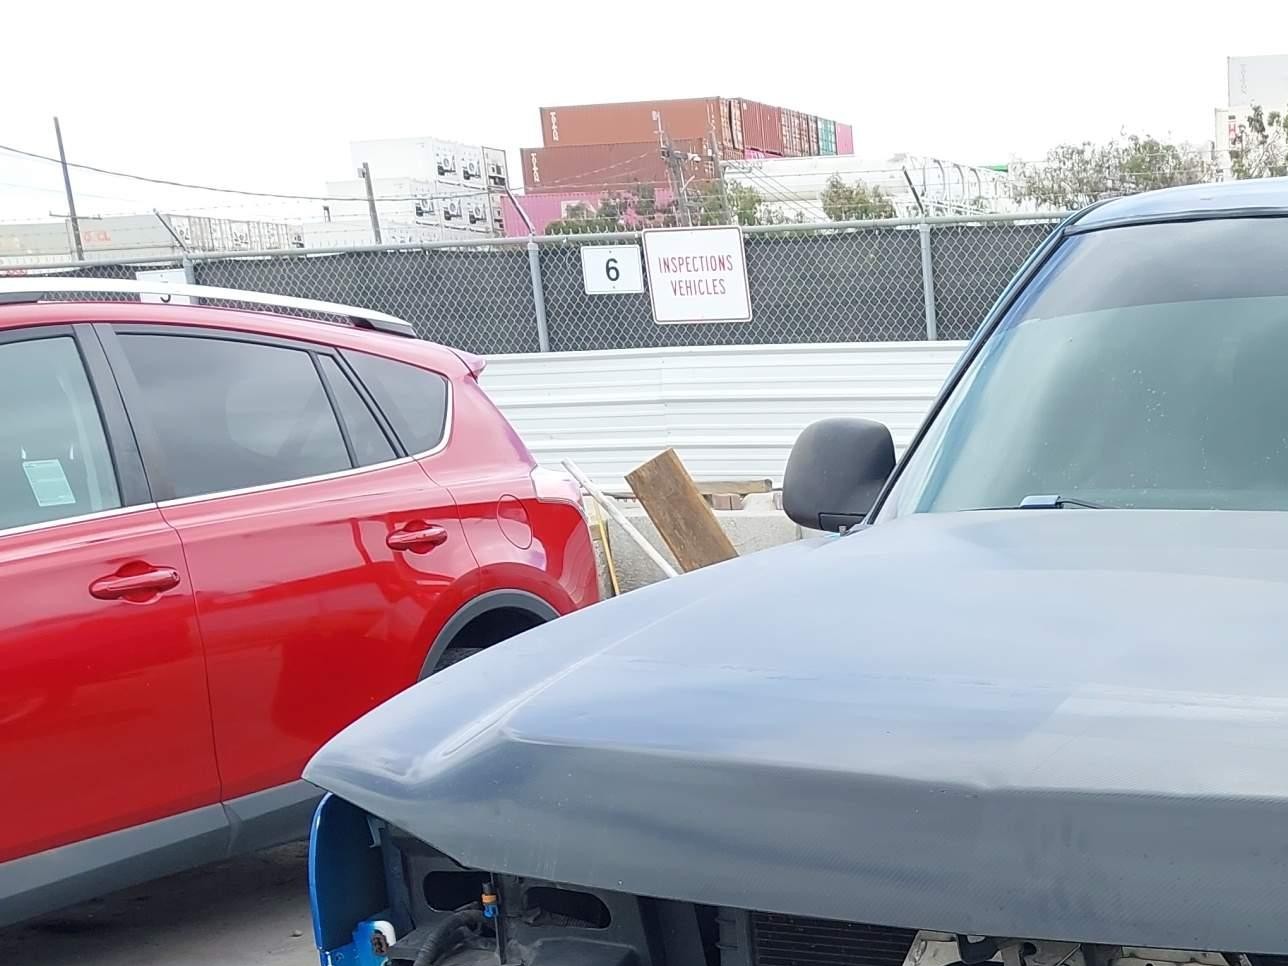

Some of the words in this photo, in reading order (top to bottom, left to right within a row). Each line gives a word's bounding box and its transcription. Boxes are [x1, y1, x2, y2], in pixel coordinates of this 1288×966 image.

[605, 258, 620, 281] 6
[658, 255, 733, 273] INSPECTIONS
[670, 279, 726, 296] VEHICLES
